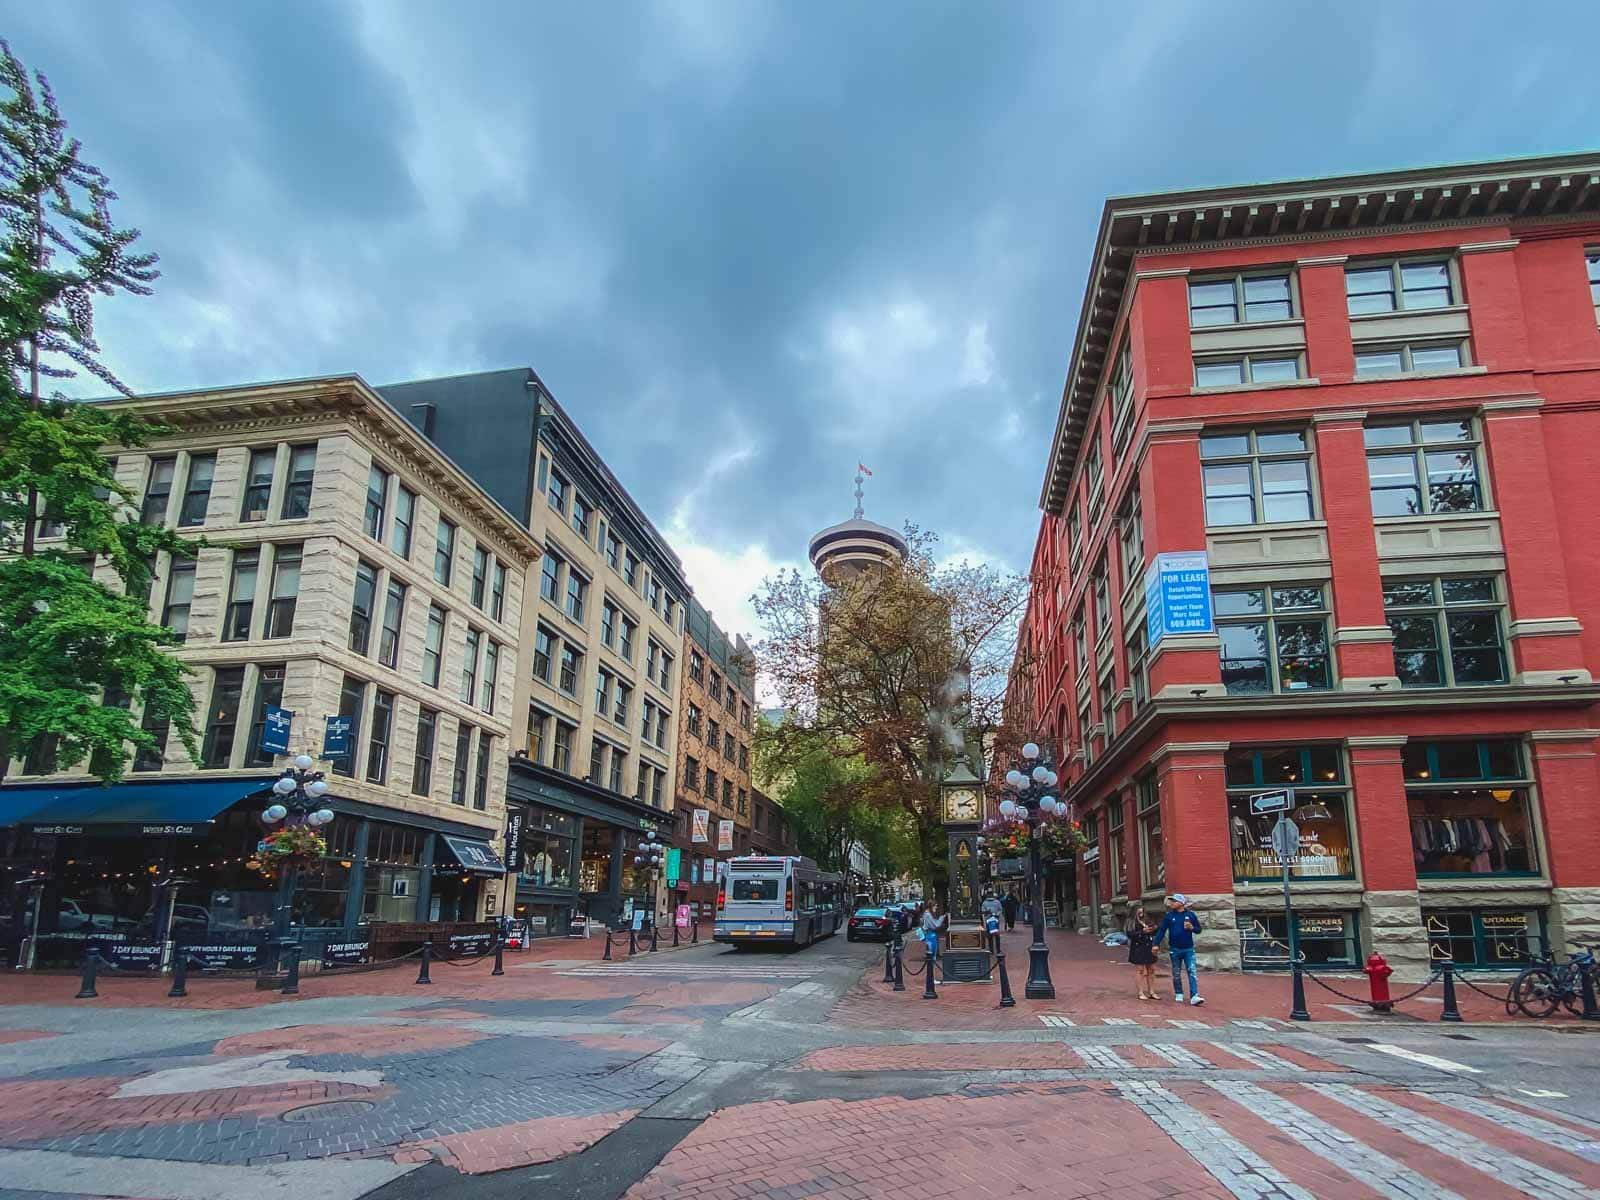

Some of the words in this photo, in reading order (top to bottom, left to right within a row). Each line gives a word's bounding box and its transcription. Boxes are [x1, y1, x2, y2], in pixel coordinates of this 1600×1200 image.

[1162, 575, 1179, 584] FOR
[1181, 573, 1207, 583] LEASE
[510, 815, 520, 849] Mountain
[1259, 856, 1272, 864] THE
[1274, 856, 1298, 864] LAEST
[117, 946, 131, 954] DAY
[331, 944, 345, 952] DAY
